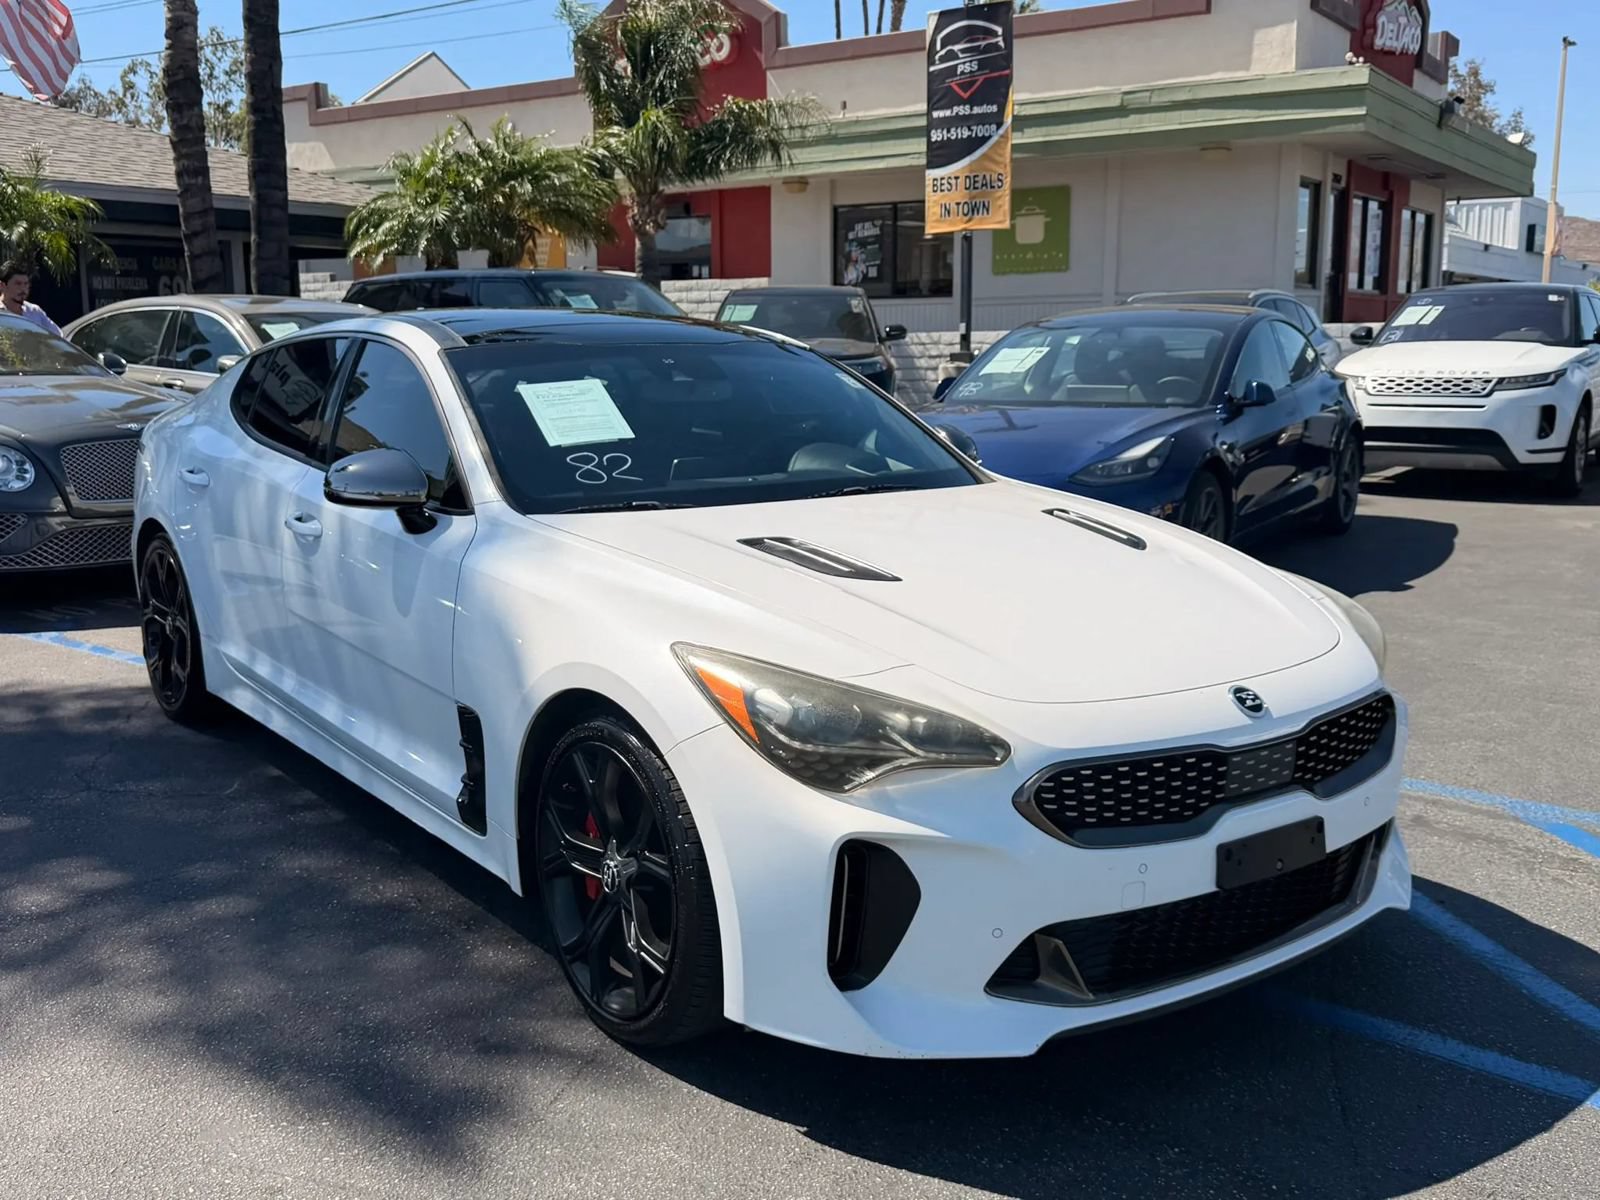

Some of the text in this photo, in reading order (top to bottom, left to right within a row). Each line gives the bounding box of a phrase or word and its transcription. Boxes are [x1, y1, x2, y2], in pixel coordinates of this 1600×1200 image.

[957, 61, 978, 75] PSS
[932, 104, 998, 119] www.PSS.autos
[930, 124, 997, 142] 951-519-7008
[932, 172, 1004, 193] BEST DEALS
[940, 200, 990, 218] IN TOWN
[566, 452, 643, 484] 82
